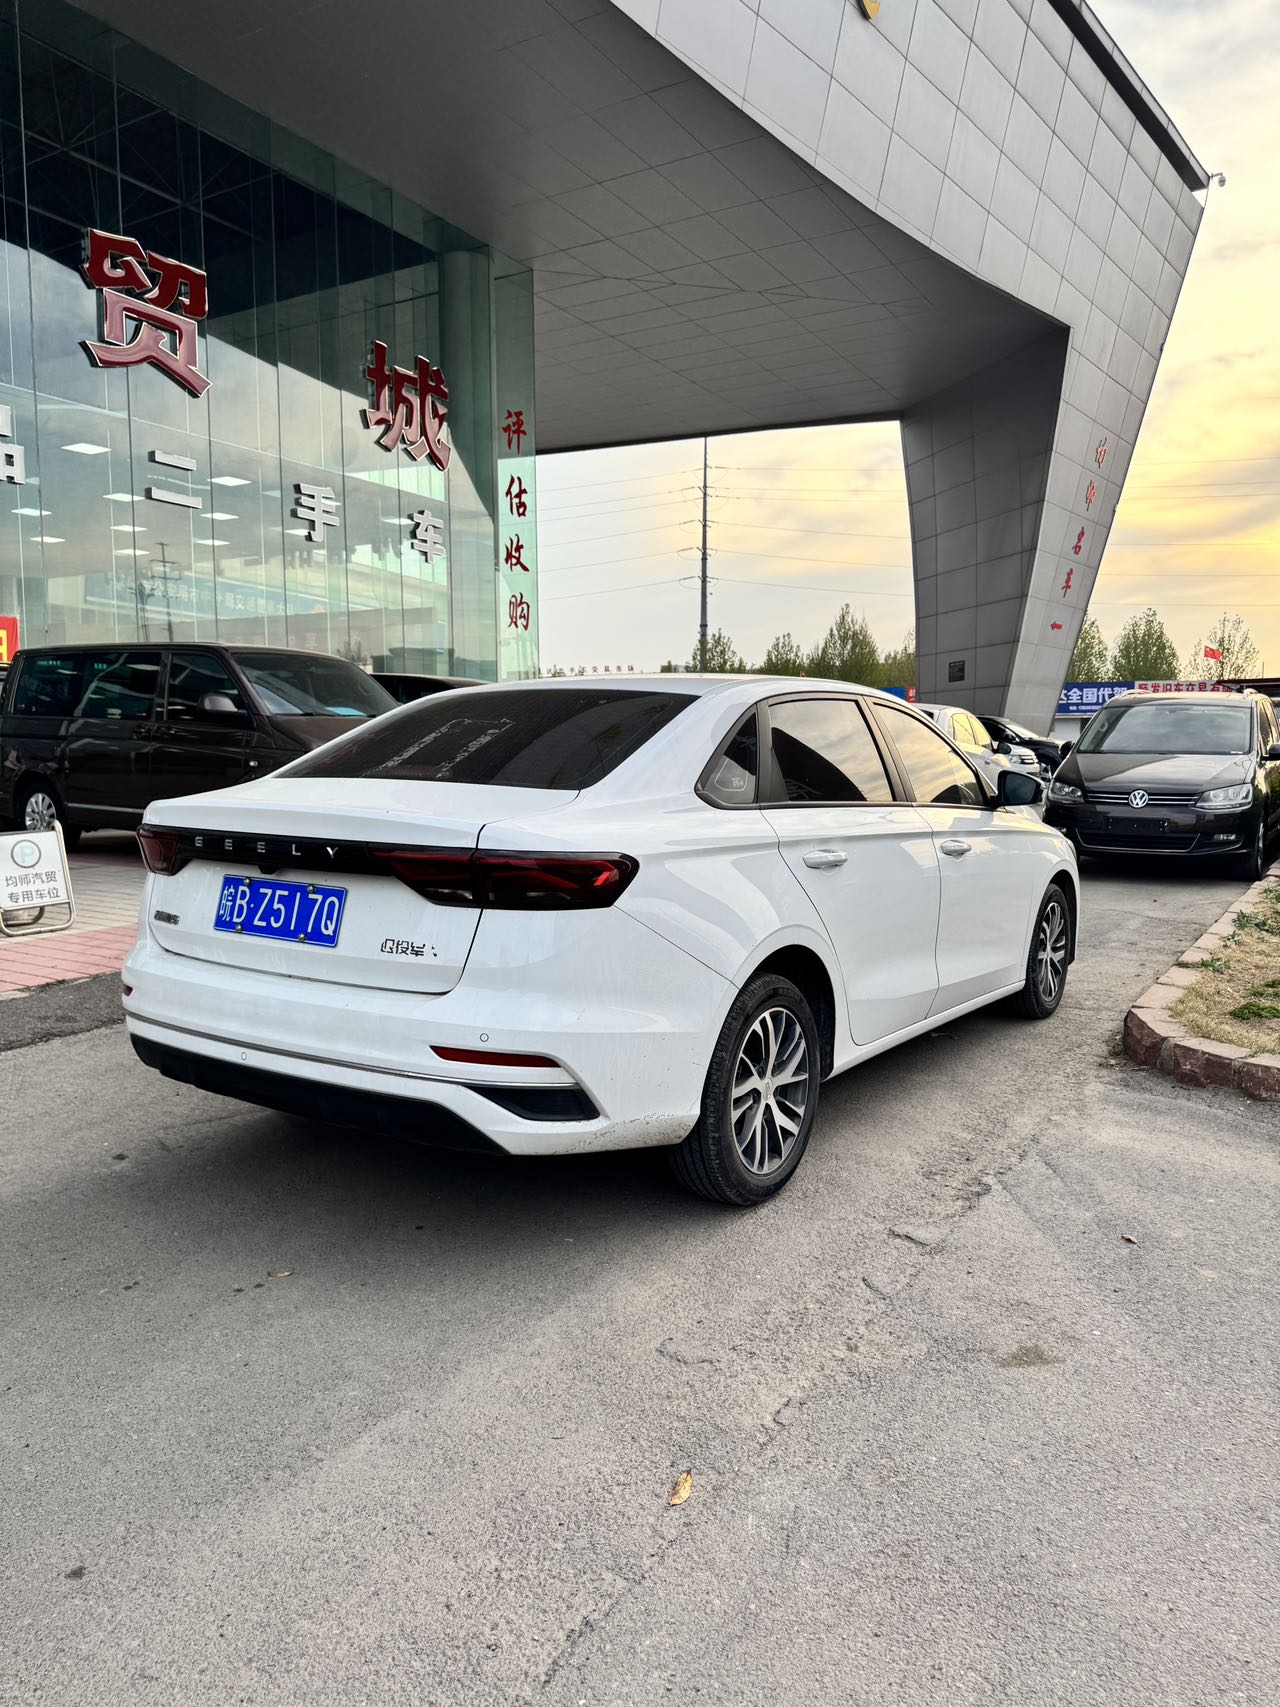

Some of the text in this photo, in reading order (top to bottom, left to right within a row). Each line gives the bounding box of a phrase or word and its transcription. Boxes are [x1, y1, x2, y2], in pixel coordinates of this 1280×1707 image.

[501, 409, 531, 632] 评估收购
[195, 836, 339, 859] GEELY
[4, 870, 58, 888] 均师汽贸
[7, 886, 61, 904] 专用车位
